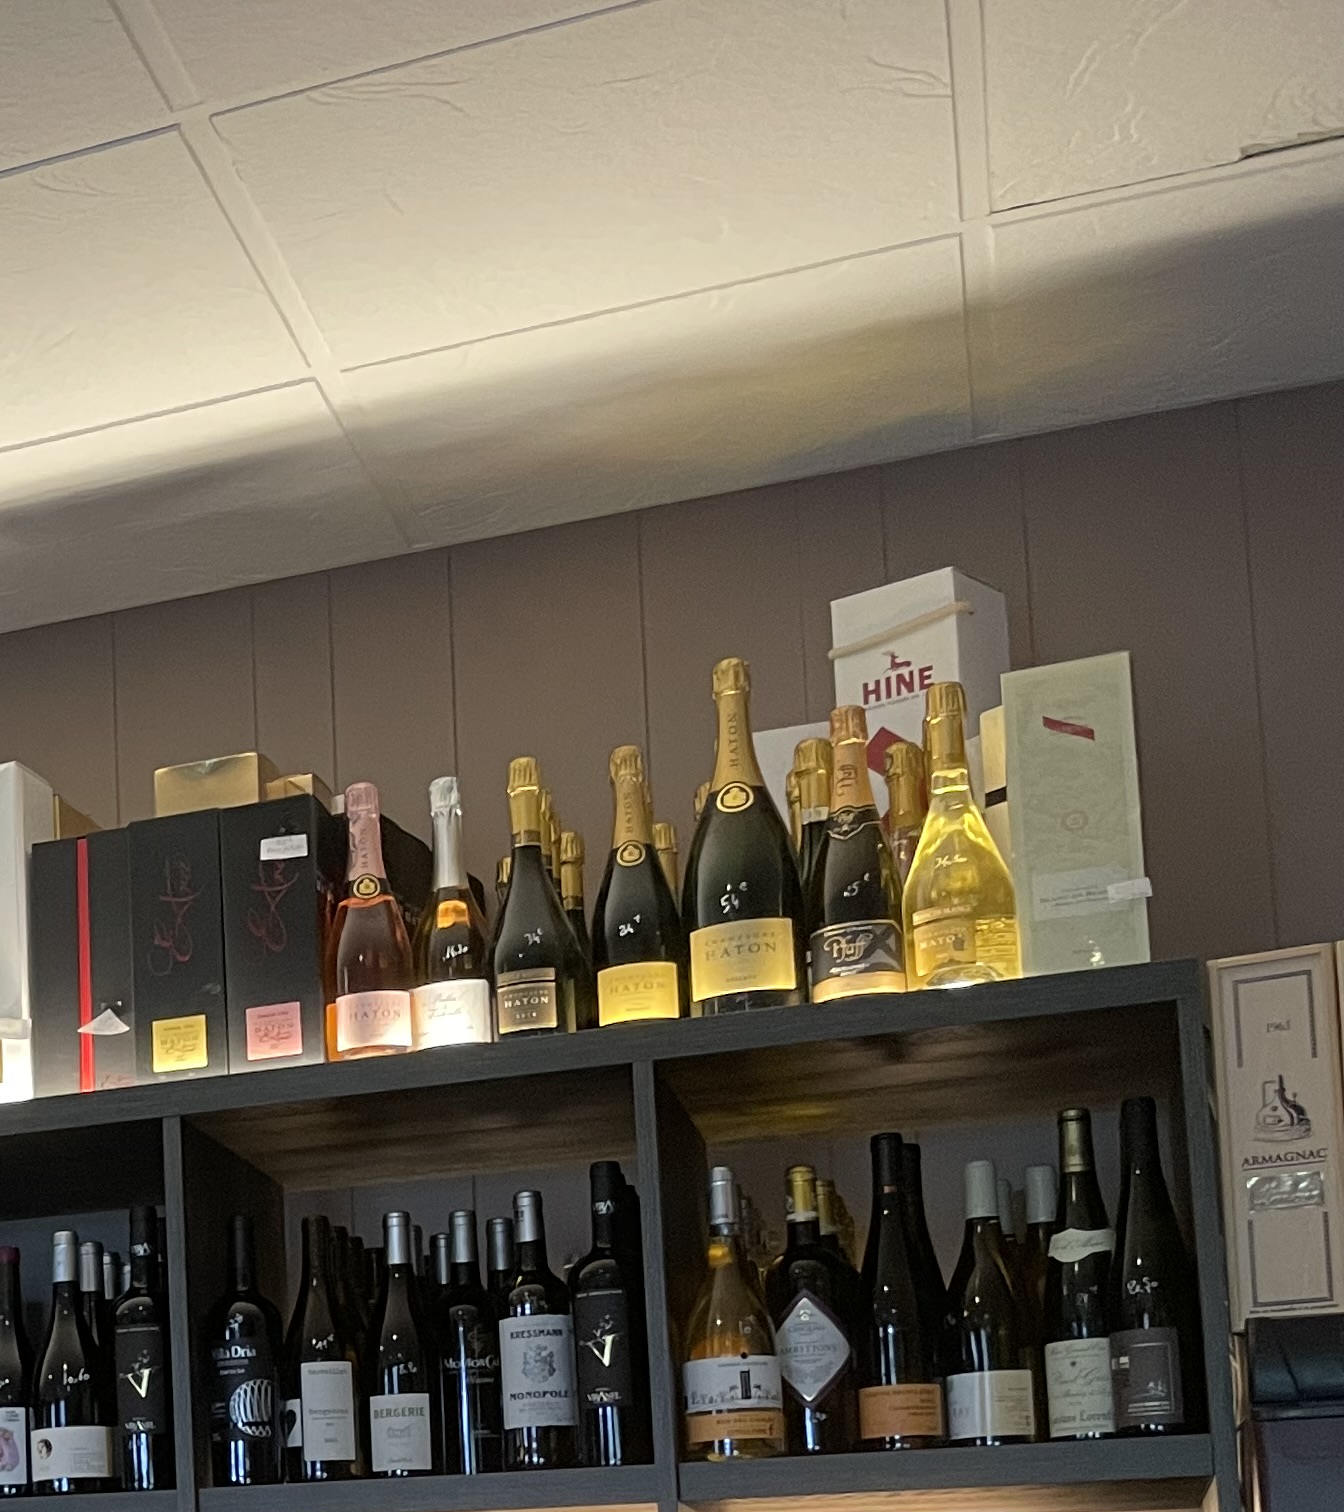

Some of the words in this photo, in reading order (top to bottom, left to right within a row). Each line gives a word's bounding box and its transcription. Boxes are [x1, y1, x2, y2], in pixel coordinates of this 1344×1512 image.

[862, 665, 934, 705] HINE
[706, 942, 776, 961] HATON
[504, 996, 549, 1009] HATON
[1242, 1147, 1328, 1168] ARMAGNAC
[510, 1328, 563, 1339] KRESSMANN
[374, 1407, 426, 1419] BERGERIE
